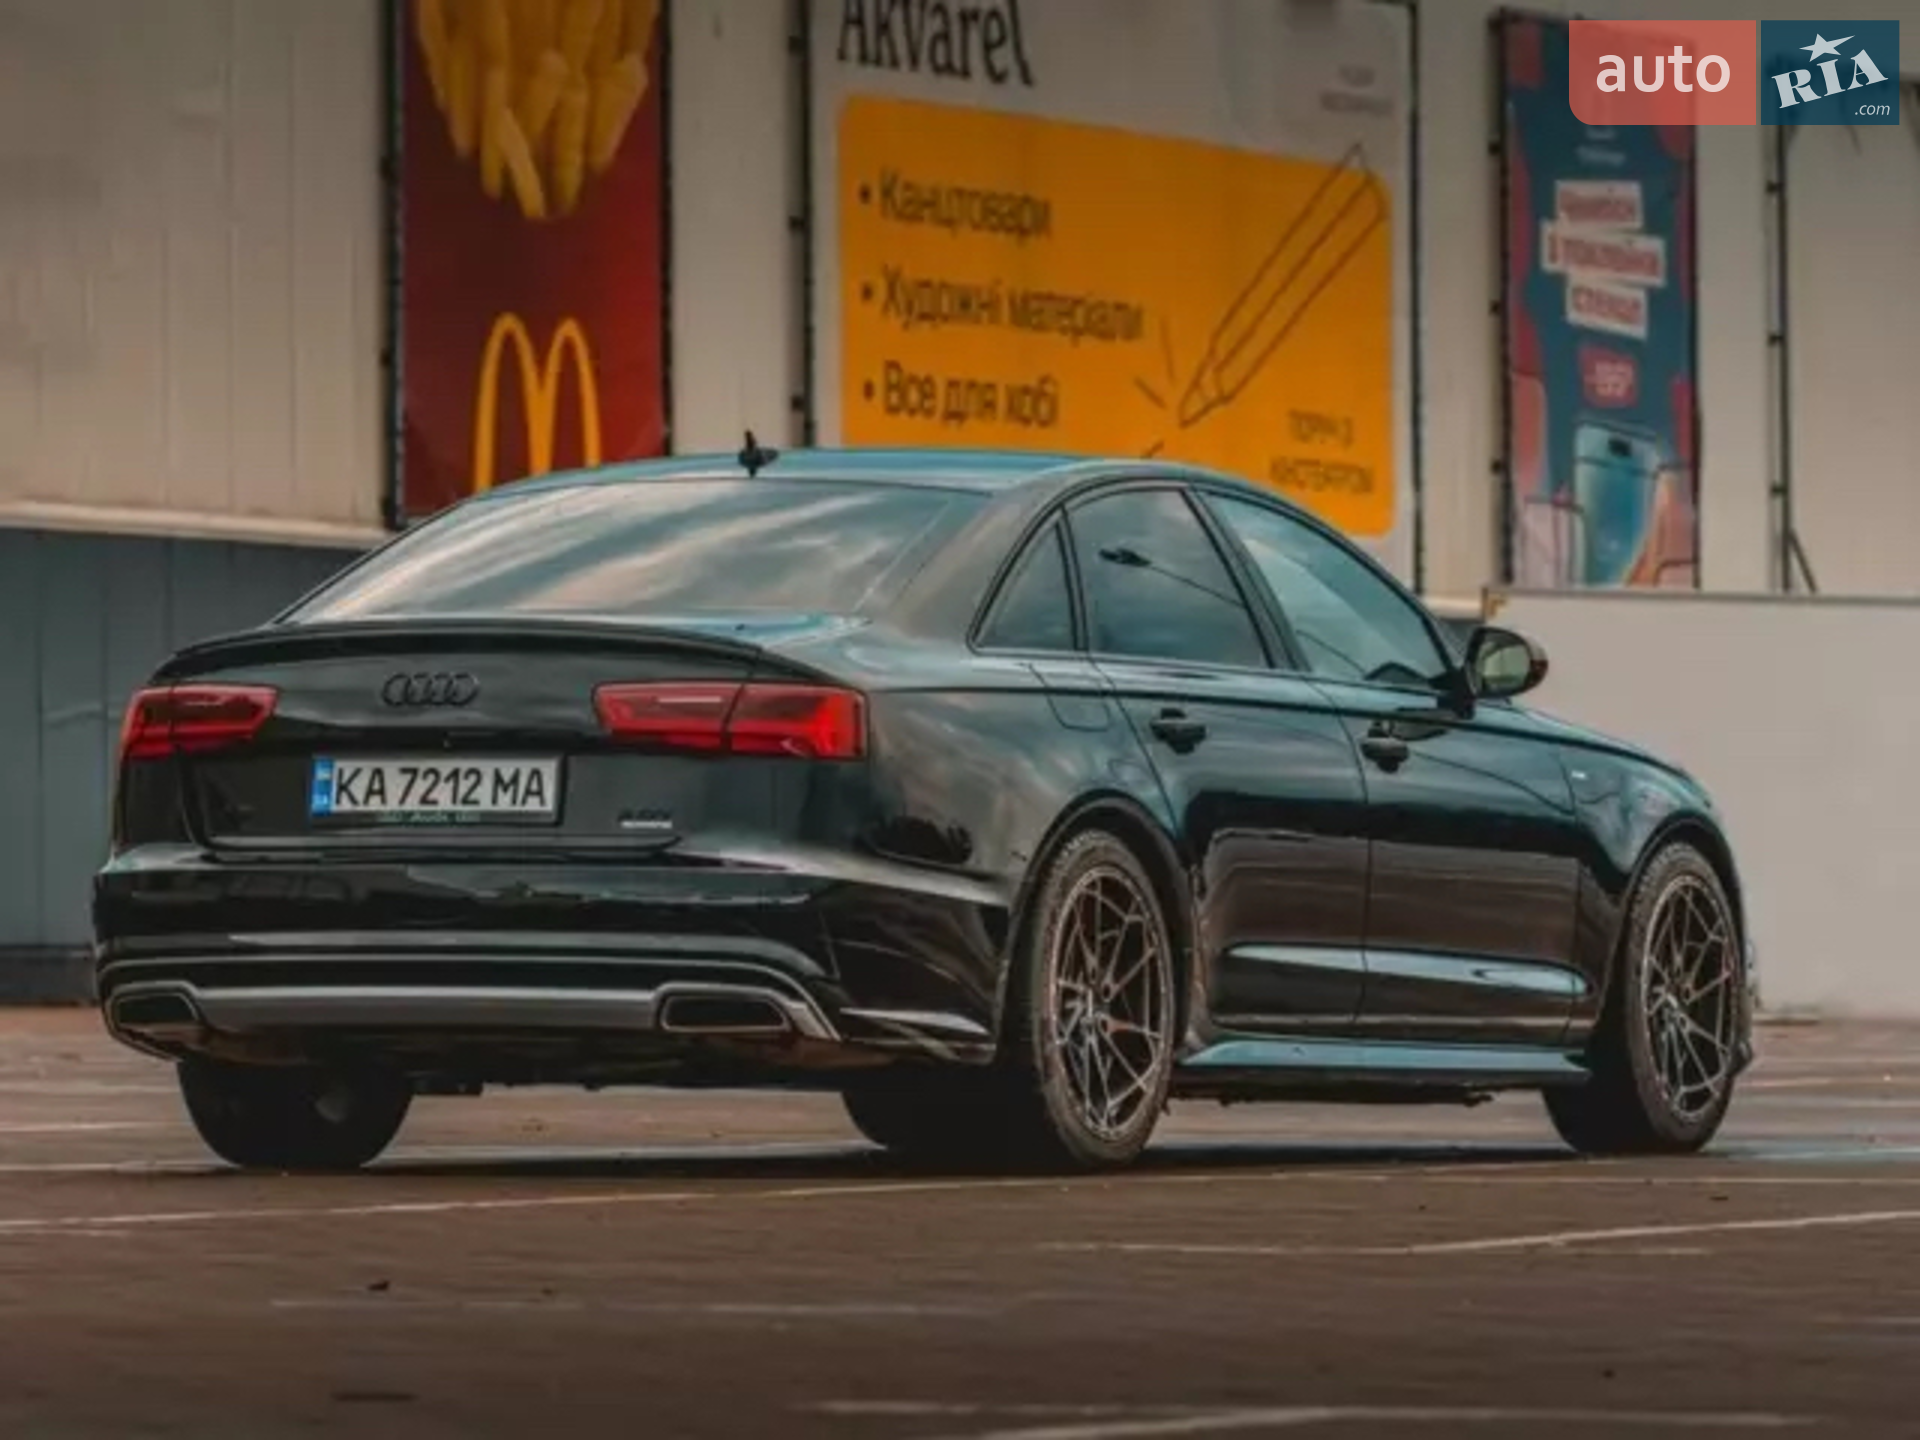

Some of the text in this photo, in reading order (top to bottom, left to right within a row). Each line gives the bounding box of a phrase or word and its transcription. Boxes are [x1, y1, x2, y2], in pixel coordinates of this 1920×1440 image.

[837, 0, 1034, 86] Akvarel
[881, 168, 1052, 245] Канцтовари
[883, 265, 1143, 346] Художні матеріали
[884, 360, 937, 417] Все
[942, 377, 997, 425] для
[334, 767, 546, 807] KA 7212 MA
